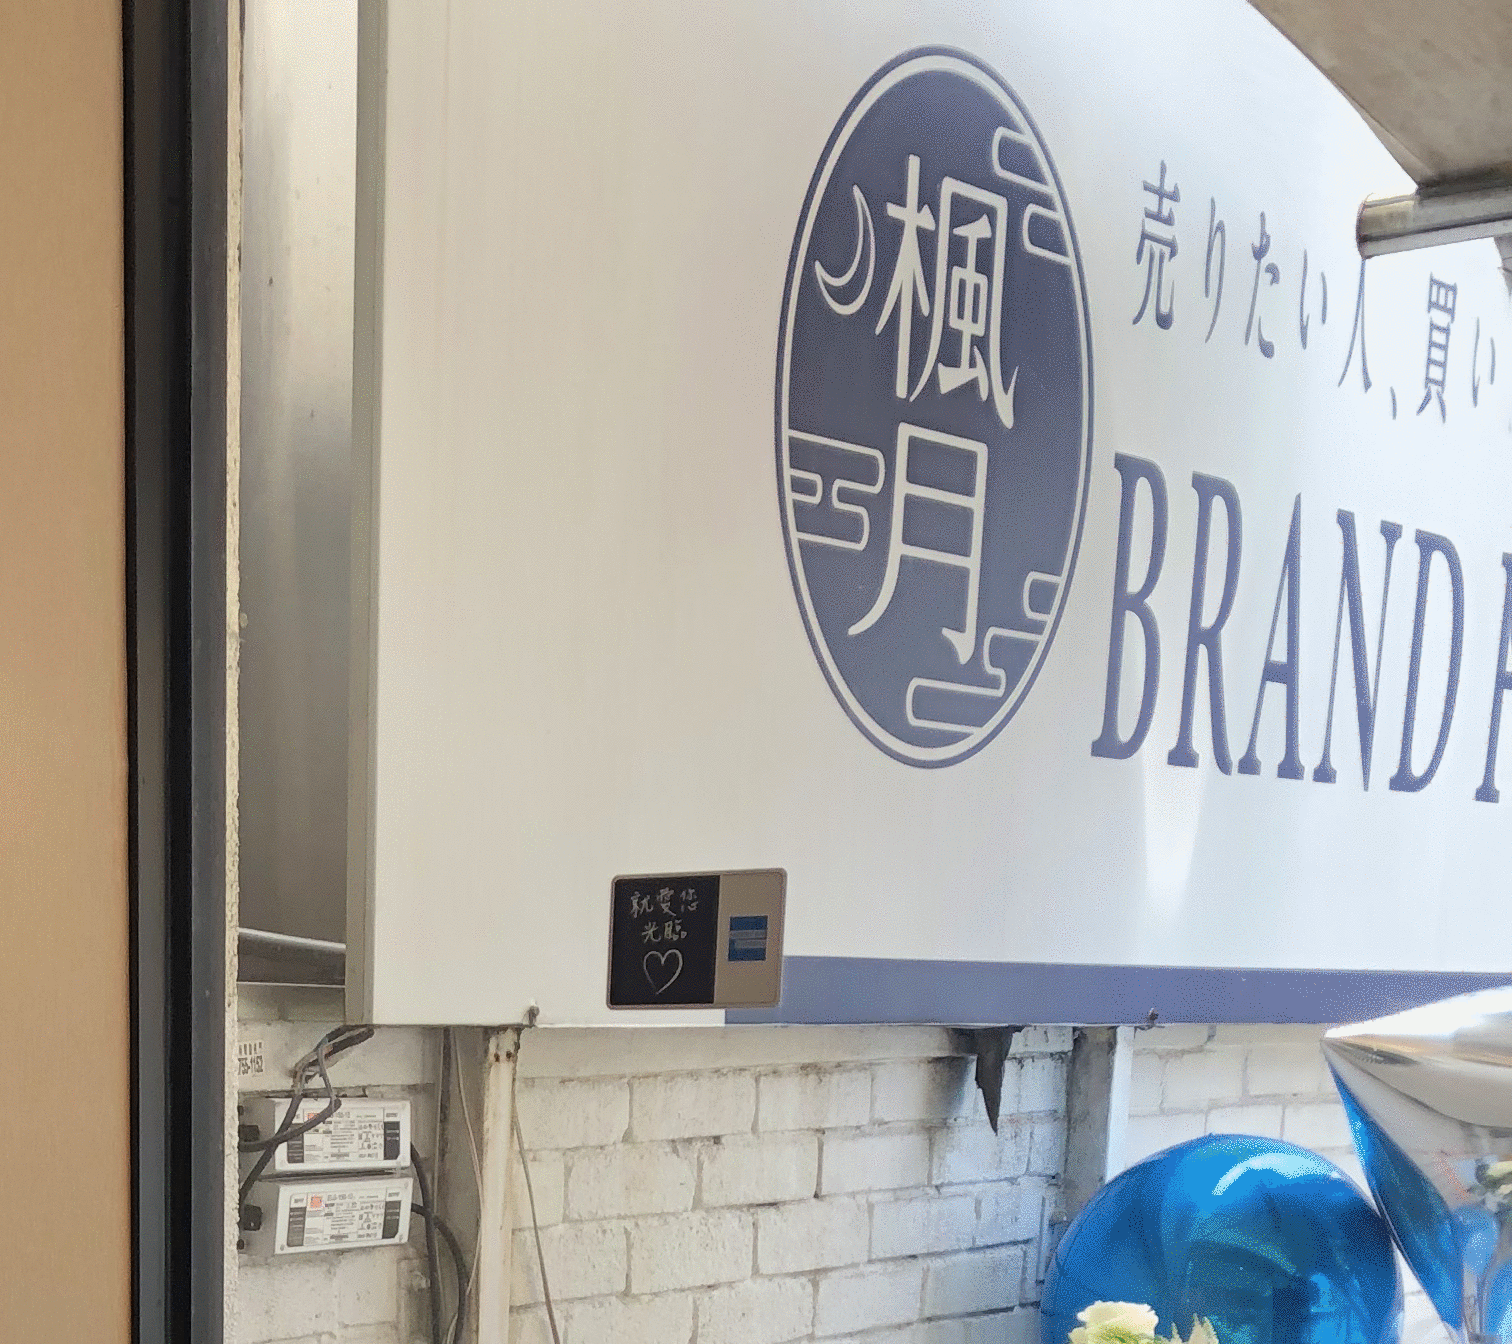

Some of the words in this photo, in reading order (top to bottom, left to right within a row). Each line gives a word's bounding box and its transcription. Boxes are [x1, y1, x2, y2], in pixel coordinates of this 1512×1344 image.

[1133, 160, 1497, 425] 売りたい人、買い
[1091, 450, 1465, 793] BRAND
